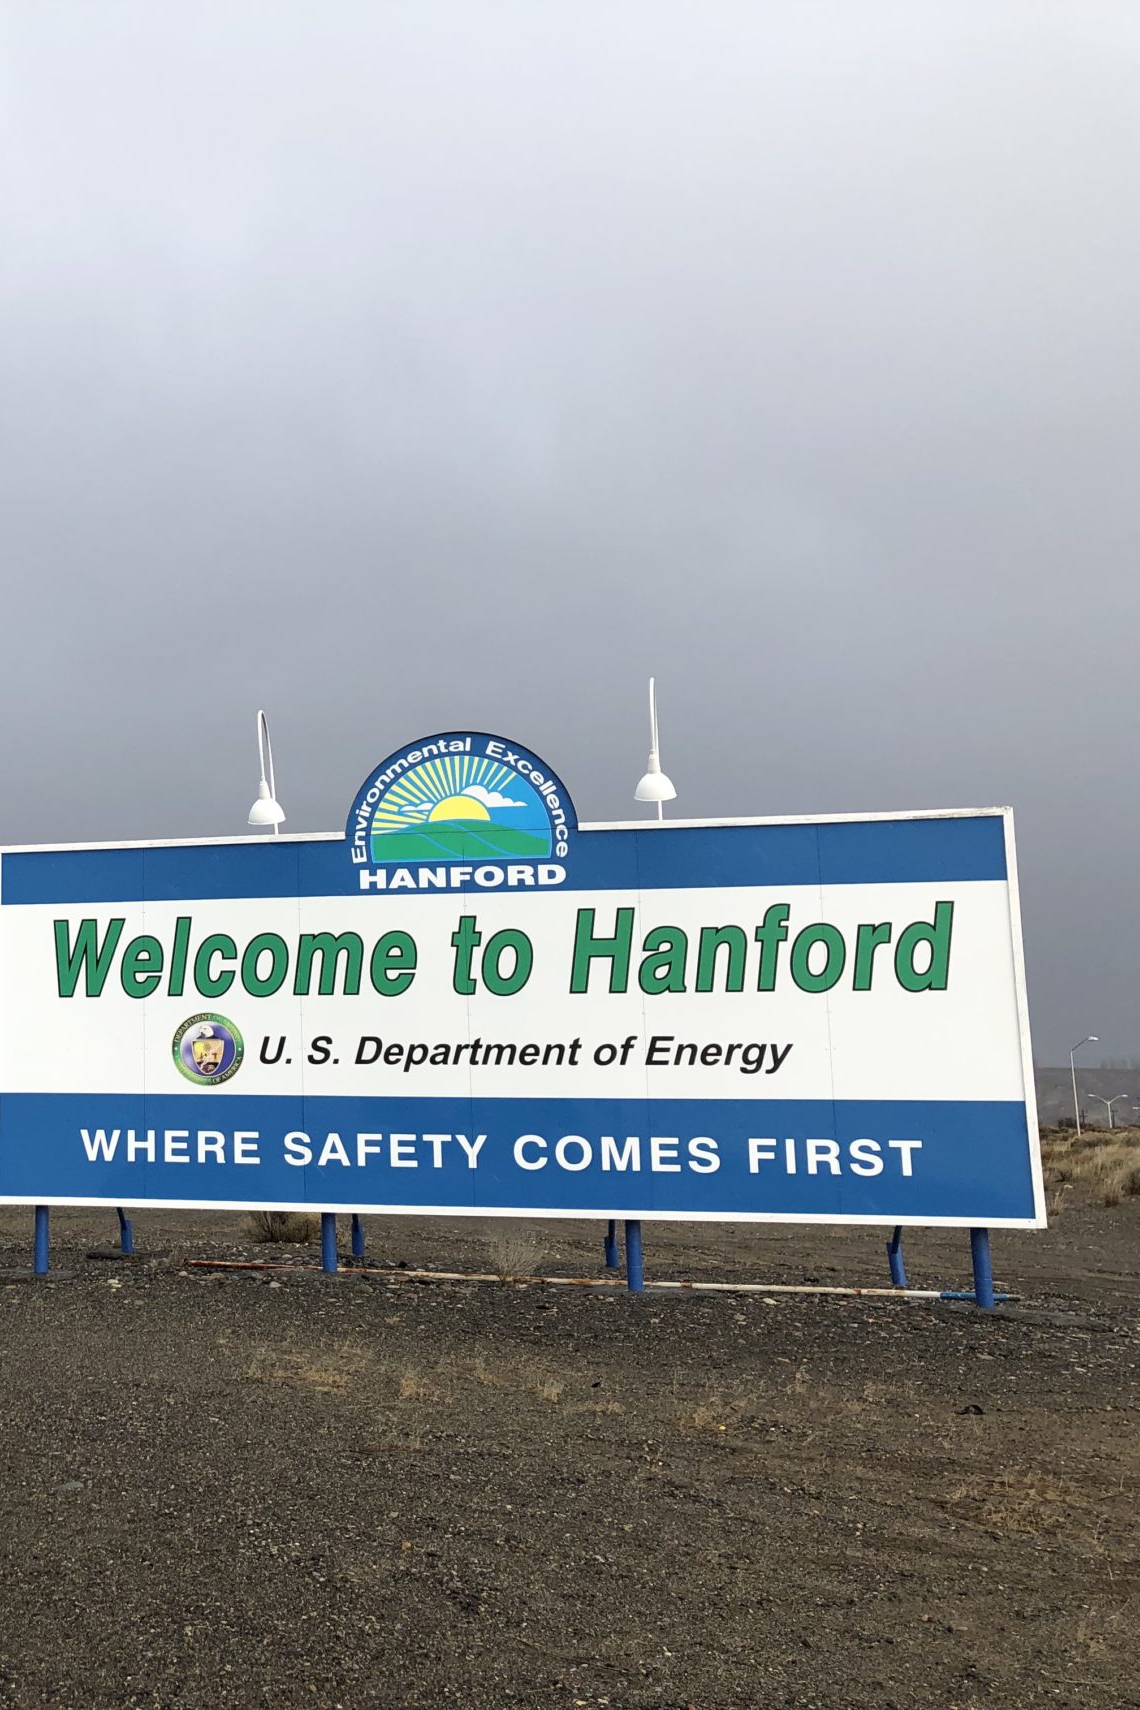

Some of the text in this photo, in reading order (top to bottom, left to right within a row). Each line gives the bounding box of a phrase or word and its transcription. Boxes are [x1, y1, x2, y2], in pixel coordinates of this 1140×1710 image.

[351, 737, 568, 863] Environmental Excellence
[360, 864, 566, 890] HANFORD
[53, 901, 955, 999] Welcome to Hanford
[259, 1035, 793, 1075] U. S. Department of Energy
[80, 1129, 923, 1177] WHERE SAFETY COMES FIRST
